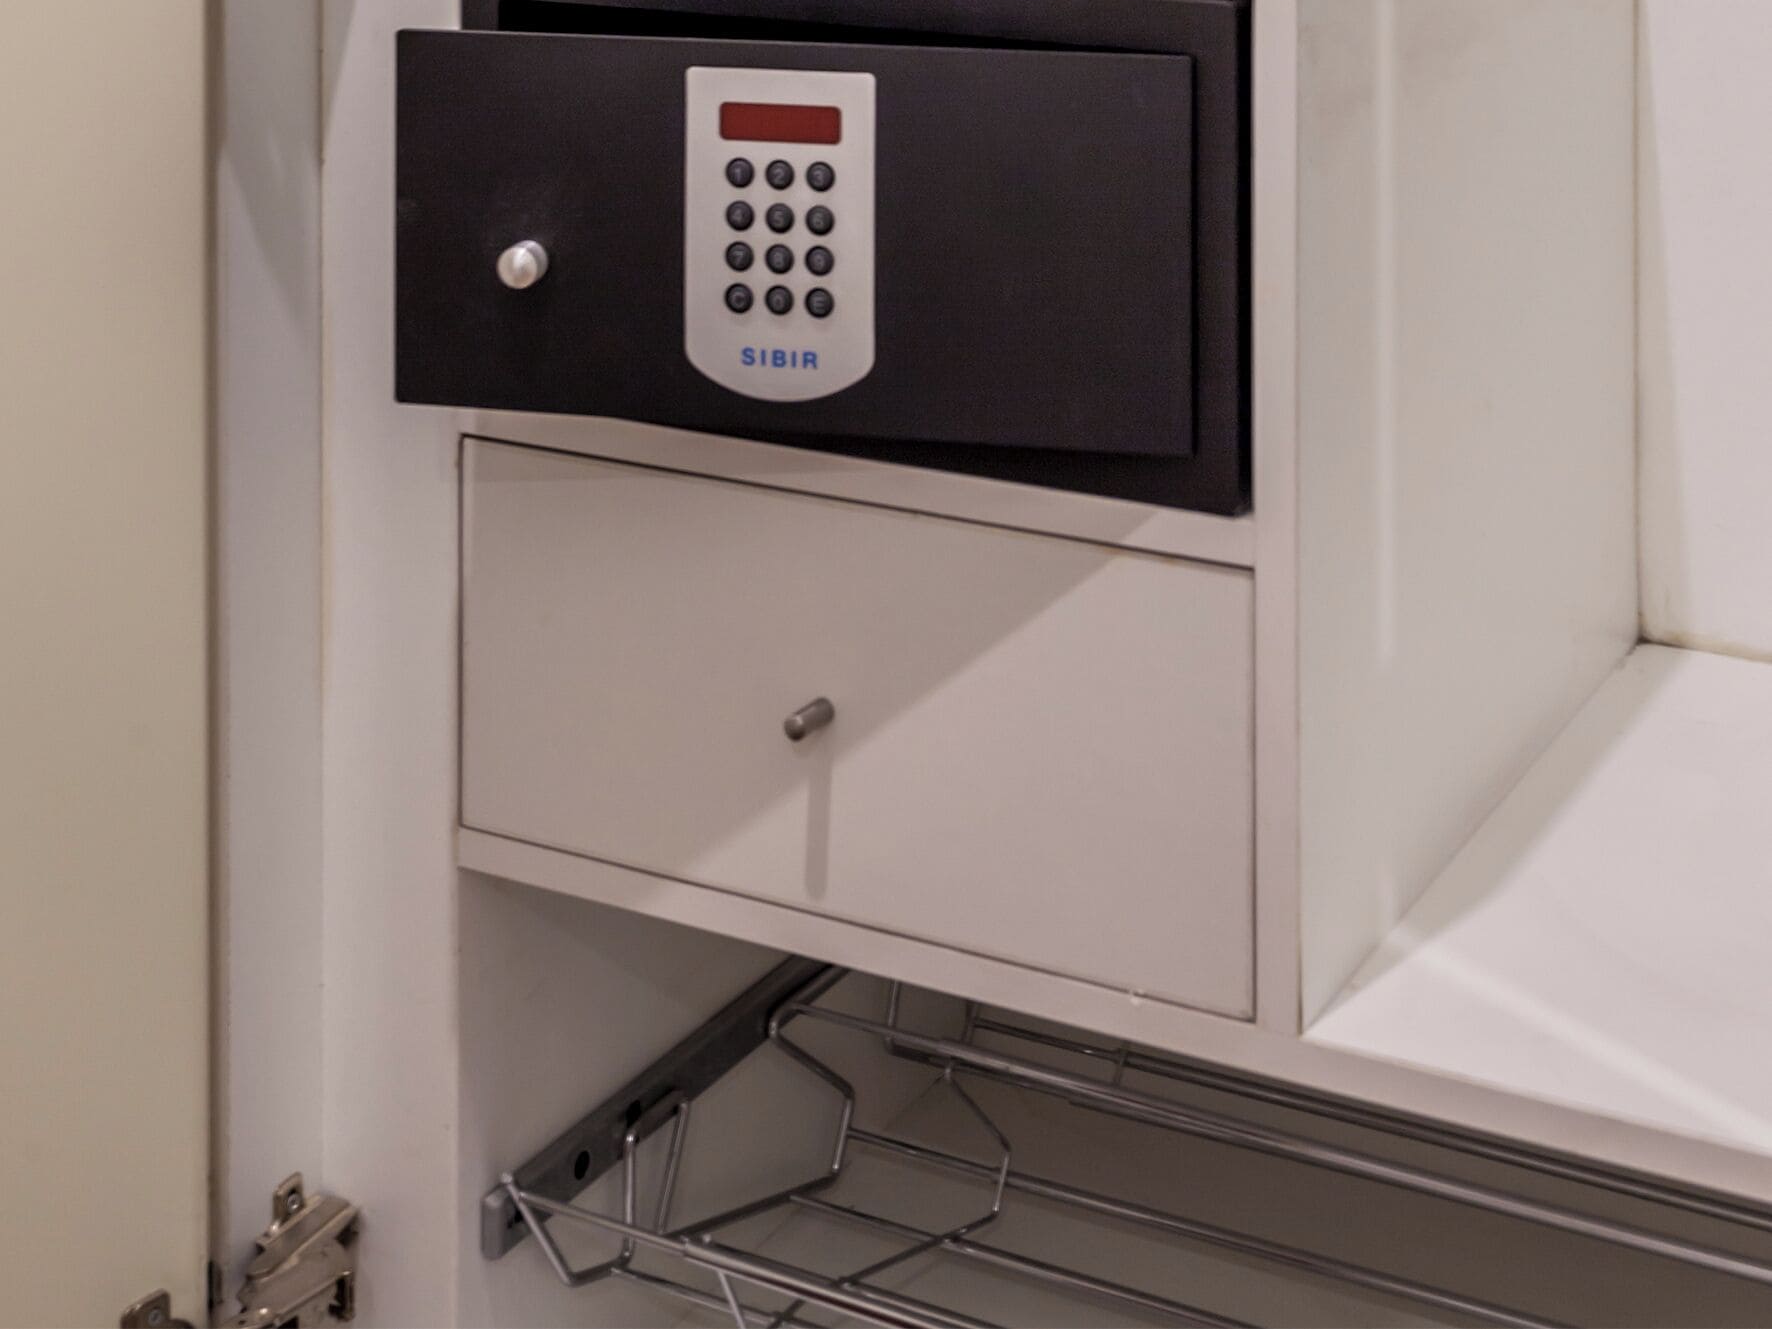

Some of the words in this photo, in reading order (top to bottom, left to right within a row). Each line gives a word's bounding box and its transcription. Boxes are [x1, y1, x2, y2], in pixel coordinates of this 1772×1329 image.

[773, 168, 786, 185] 2
[813, 170, 825, 187] 3
[731, 210, 744, 225] 4
[773, 211, 785, 228] 5
[812, 212, 824, 229] 6
[733, 251, 745, 267] 7
[774, 252, 785, 269] 8
[812, 296, 825, 314] E
[741, 346, 818, 369] SIBIR
